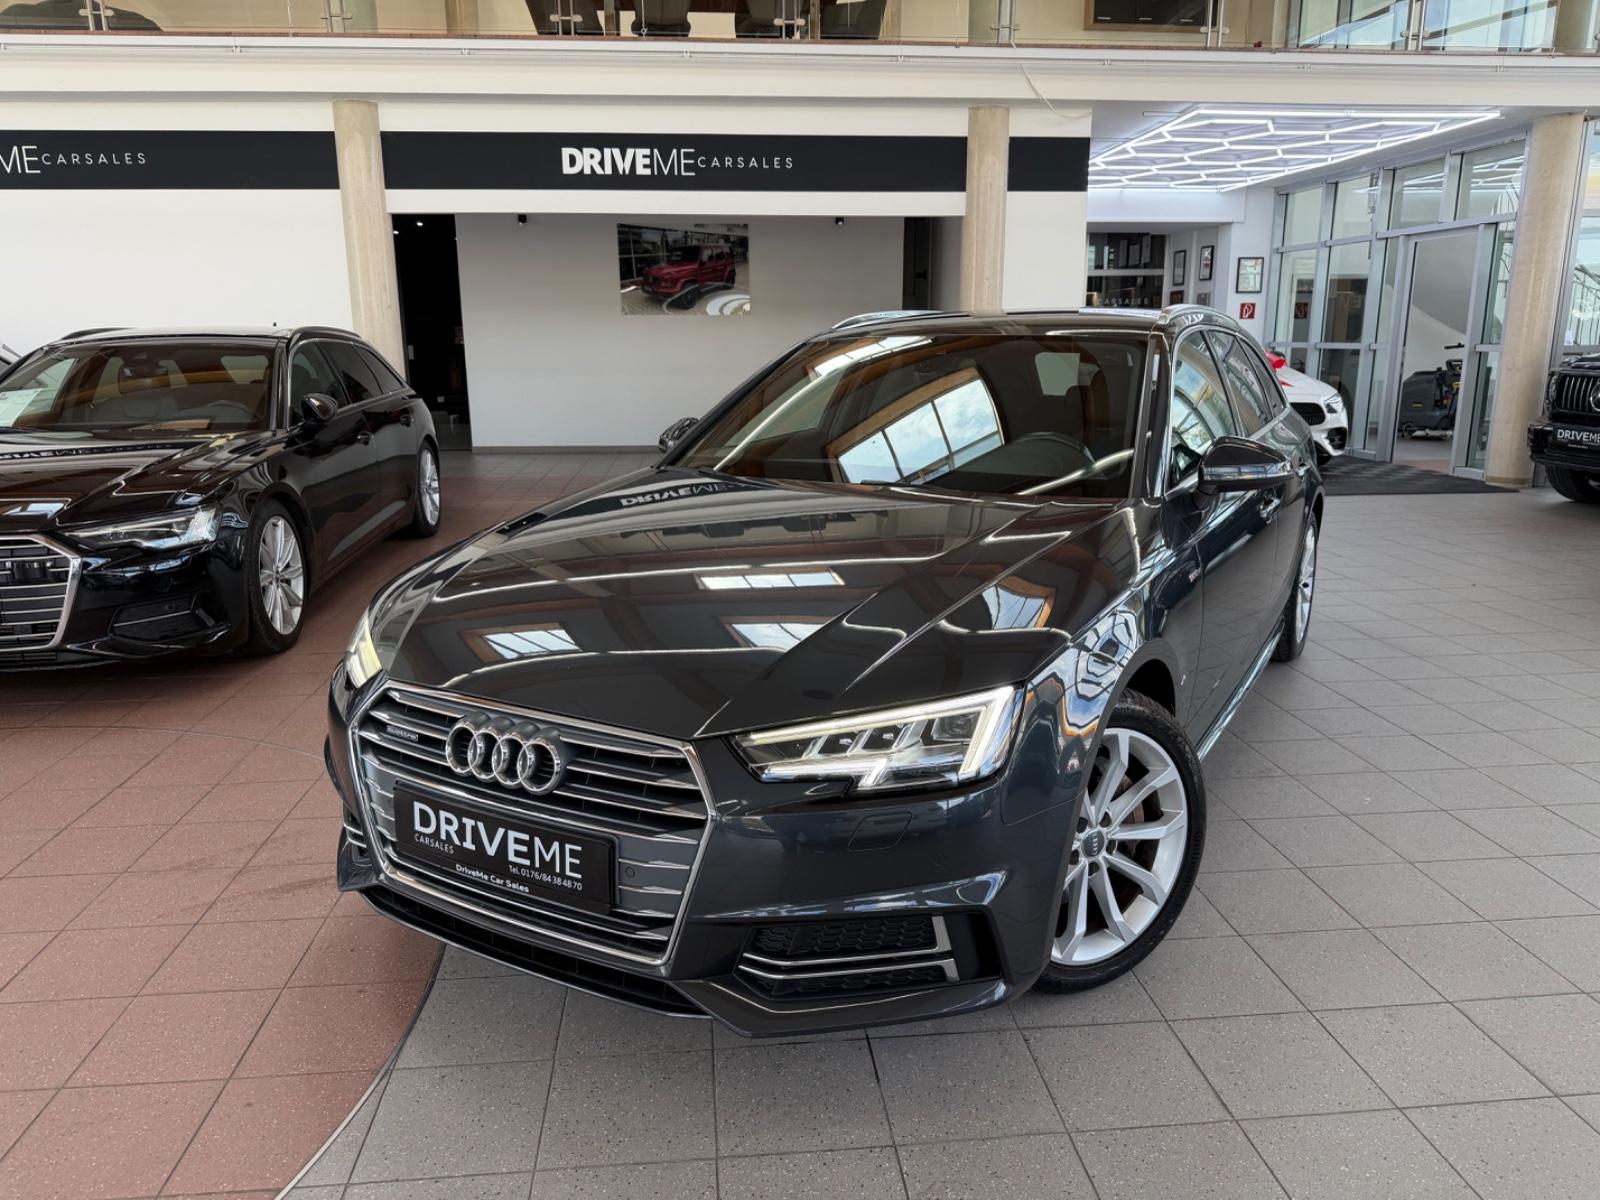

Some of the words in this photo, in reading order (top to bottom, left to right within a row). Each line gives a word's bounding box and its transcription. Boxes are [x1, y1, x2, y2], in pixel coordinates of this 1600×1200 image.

[41, 153, 146, 165] CARSALES
[561, 147, 696, 176] DRIVEME
[697, 157, 793, 169] CARSALES
[413, 801, 582, 879] DRIVEME
[414, 833, 455, 855] CARSALES
[455, 864, 489, 881] DriveMe
[489, 875, 505, 885] Car
[505, 879, 530, 893] Sales
